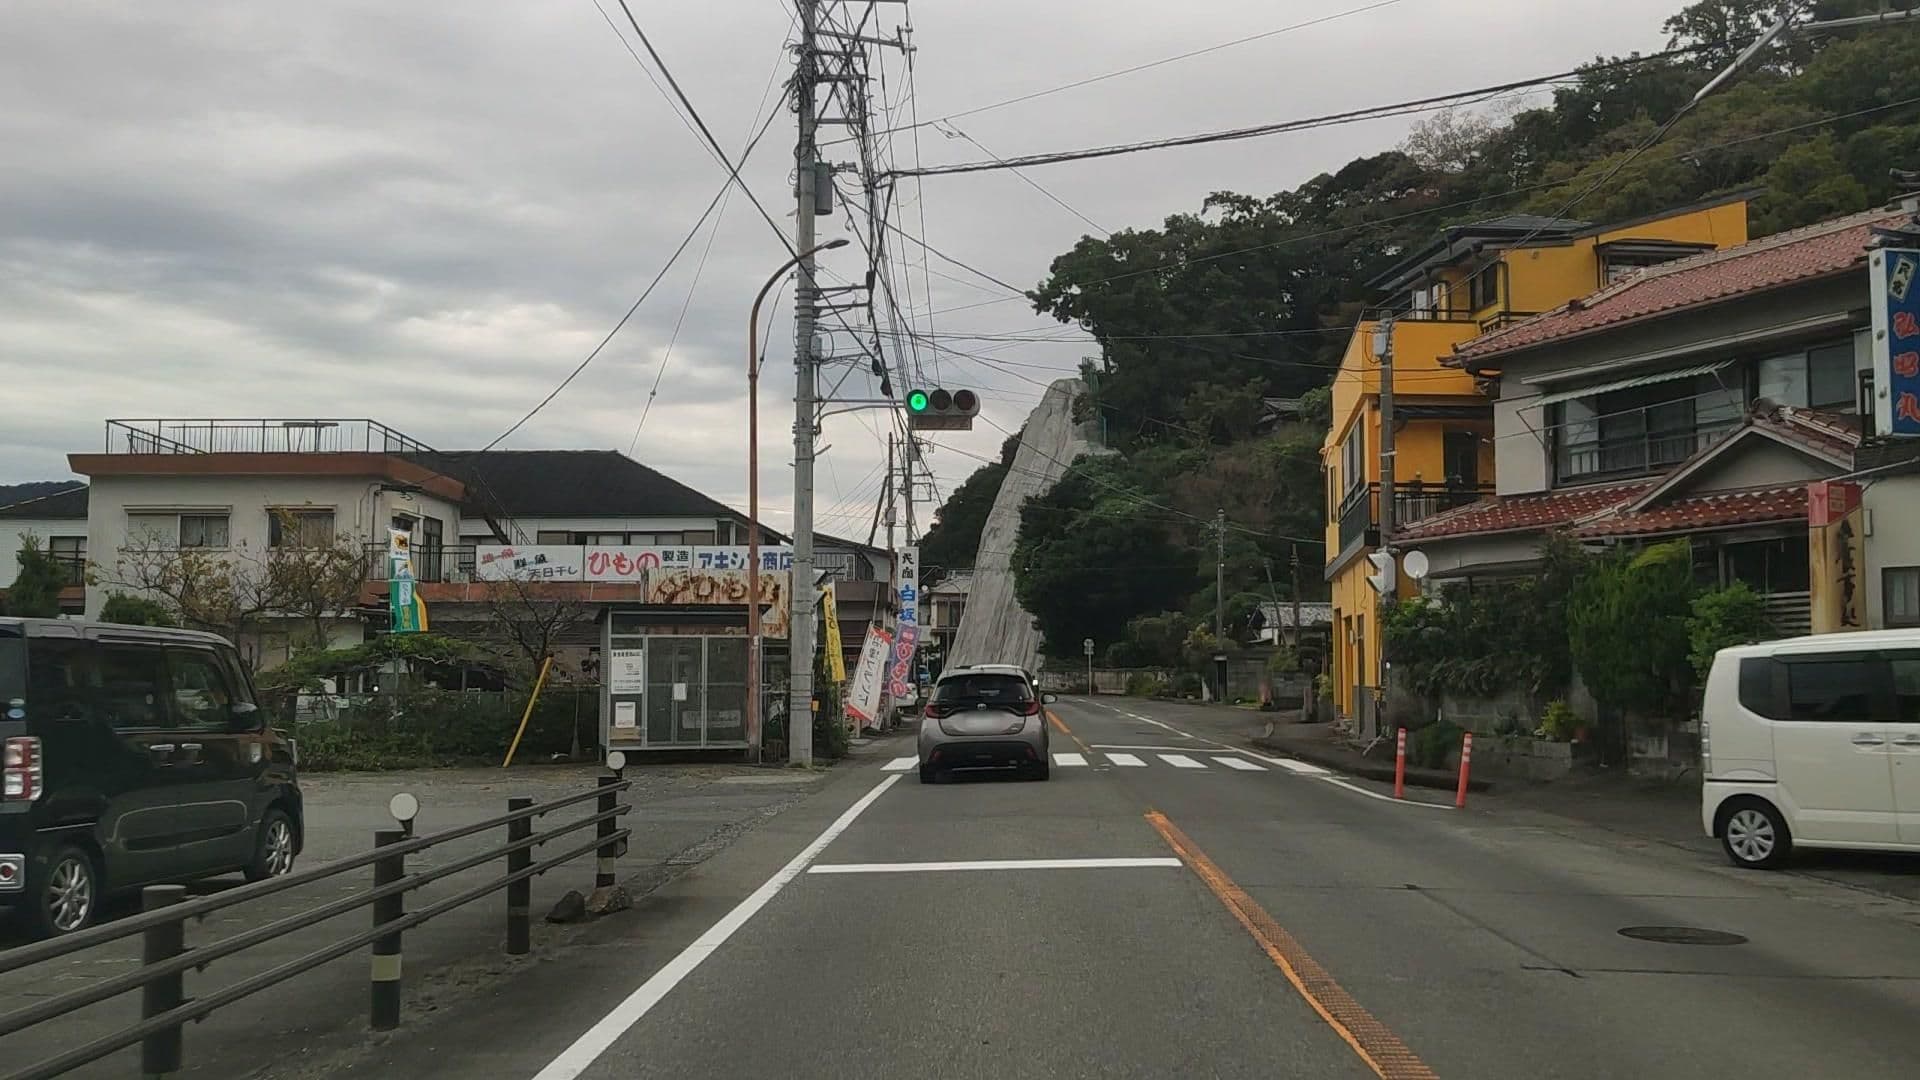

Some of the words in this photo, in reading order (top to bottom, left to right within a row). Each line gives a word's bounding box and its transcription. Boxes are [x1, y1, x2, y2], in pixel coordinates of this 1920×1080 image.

[588, 552, 660, 576] ひもの
[661, 550, 689, 562] 製造
